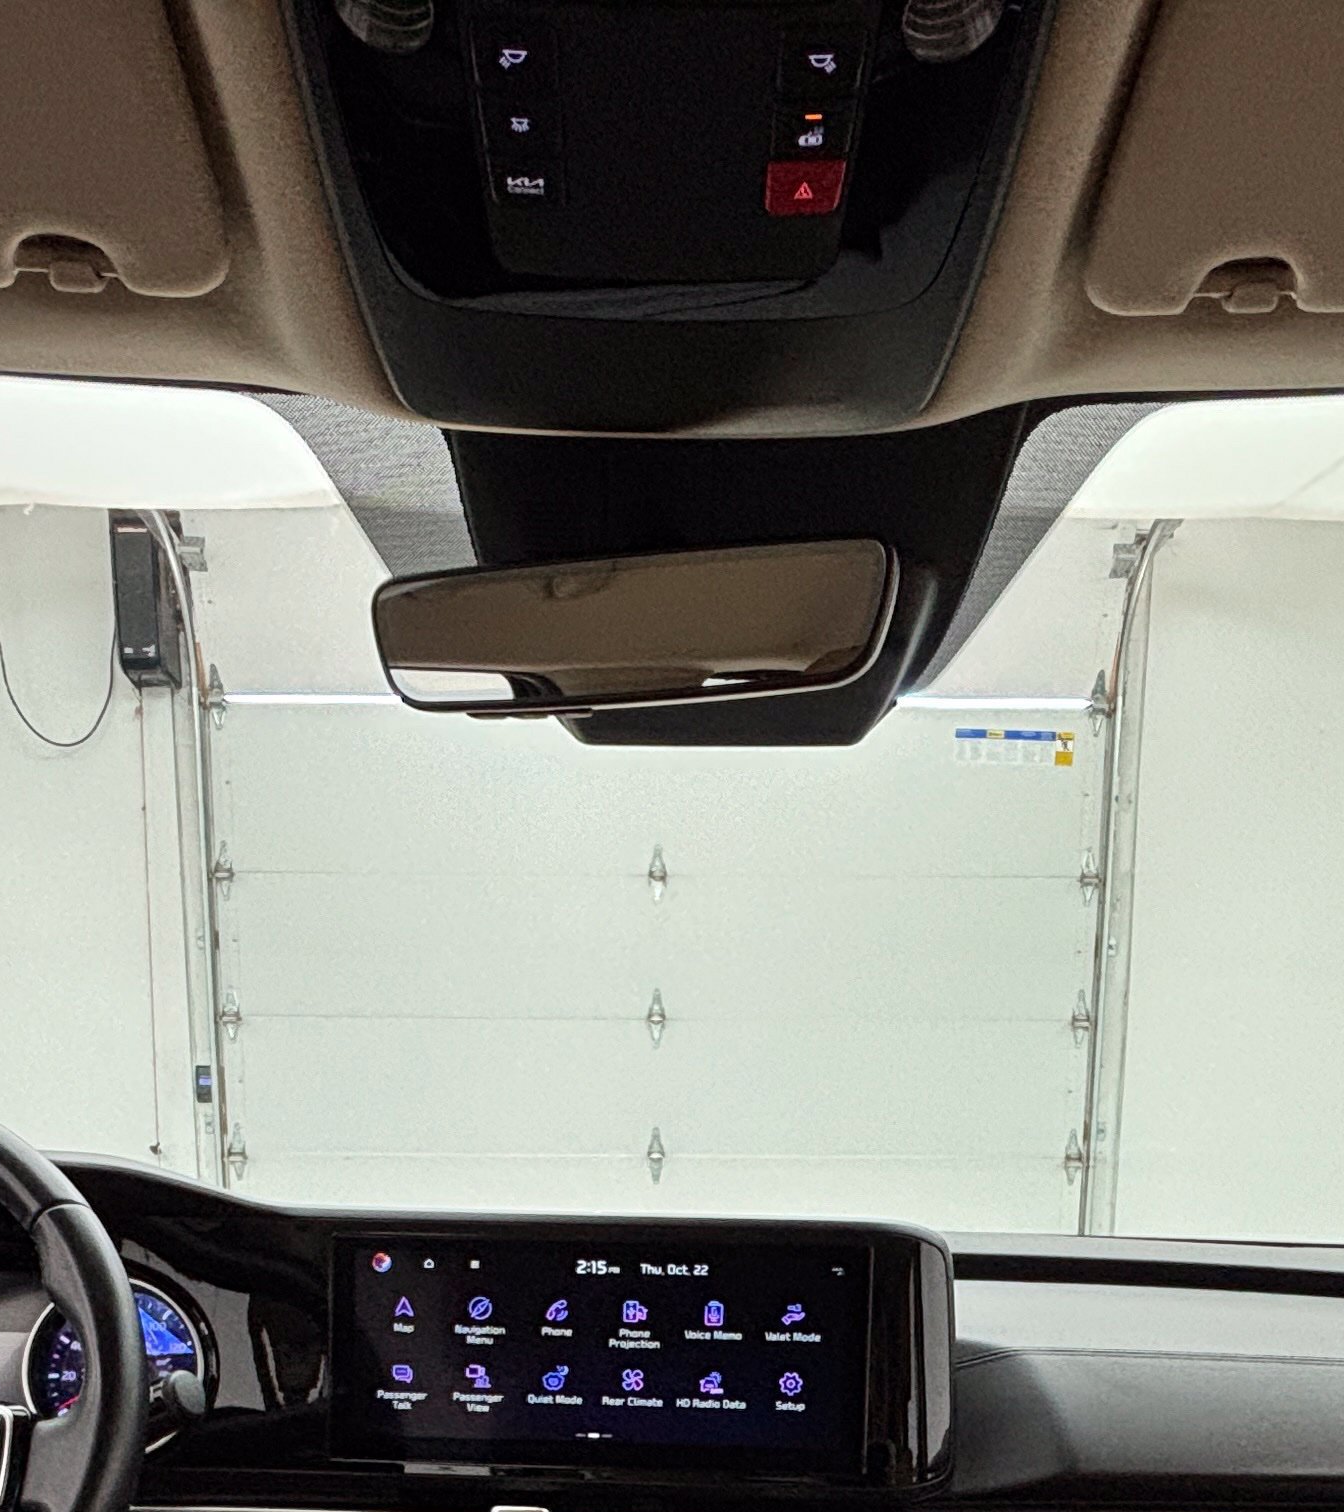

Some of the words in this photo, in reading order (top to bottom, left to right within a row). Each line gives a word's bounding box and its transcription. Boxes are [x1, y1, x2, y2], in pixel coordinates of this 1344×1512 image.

[576, 1260, 607, 1274] 2:15
[694, 1265, 709, 1276] 22
[393, 1323, 415, 1334] Map
[454, 1325, 506, 1337] Navigation
[541, 1326, 573, 1337] Phone
[619, 1329, 651, 1339] Phone
[467, 1335, 494, 1345] Menu
[684, 1330, 712, 1340] Voice
[713, 1331, 743, 1341] Memo
[765, 1332, 791, 1342] Valet
[793, 1332, 821, 1342] Mode
[609, 1338, 660, 1350] Projection
[61, 1370, 77, 1382] 20
[376, 1390, 428, 1402] Passenger
[453, 1391, 504, 1403] Passenger
[527, 1394, 554, 1404] Quiet
[556, 1395, 583, 1405] Mode
[602, 1396, 625, 1406] Rear
[627, 1397, 663, 1407] Climate
[467, 1402, 490, 1412] View
[676, 1398, 691, 1408] HD
[692, 1399, 721, 1409] Radio
[722, 1400, 747, 1410] Data
[775, 1401, 806, 1412] Setup
